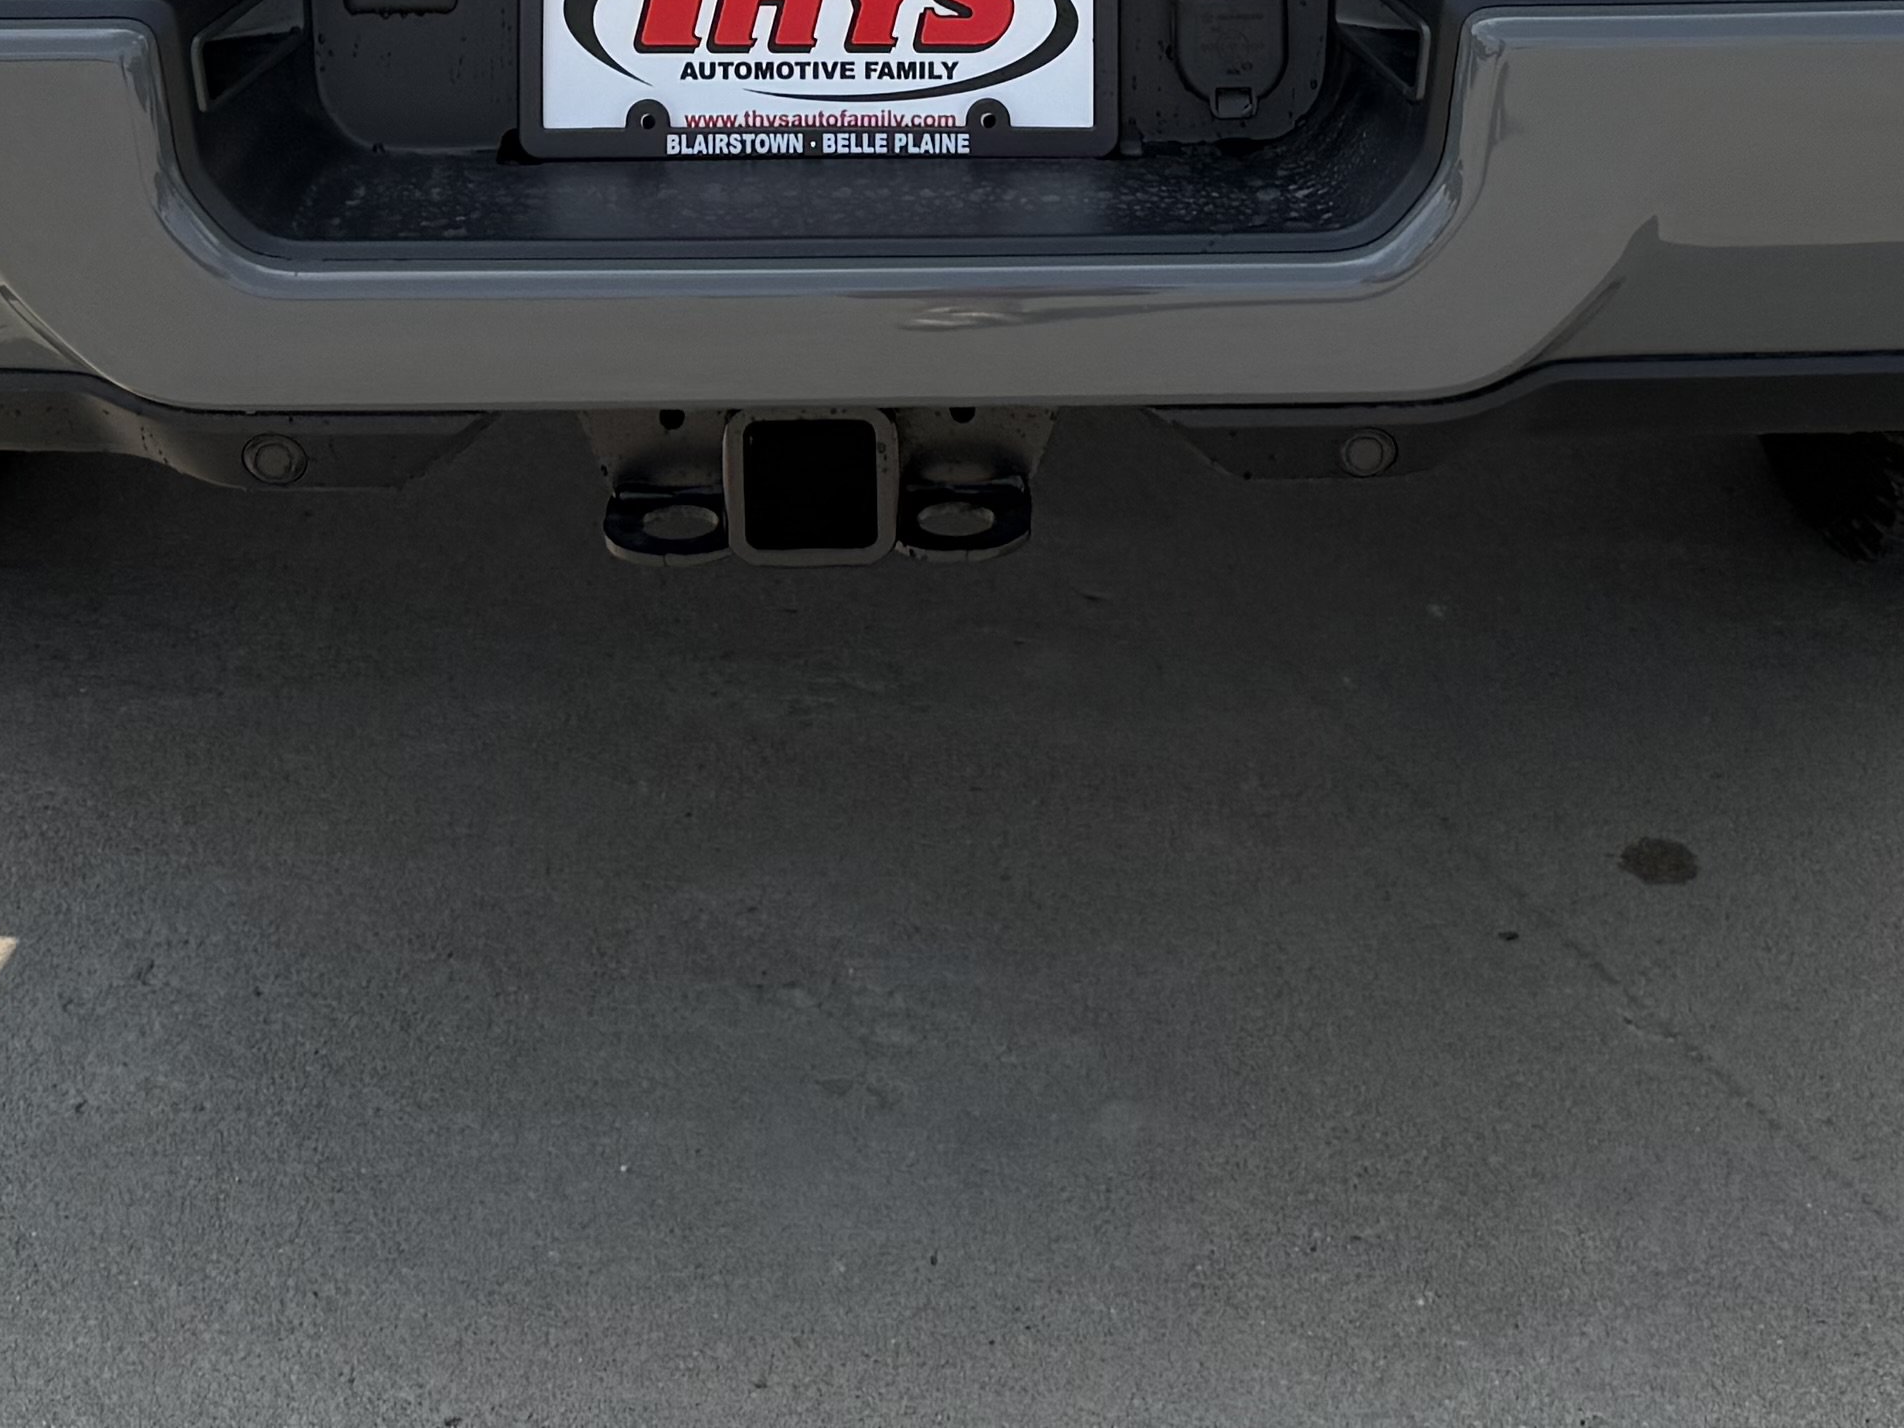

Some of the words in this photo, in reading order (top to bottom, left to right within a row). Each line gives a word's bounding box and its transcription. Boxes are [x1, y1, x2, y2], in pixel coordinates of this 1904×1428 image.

[679, 61, 857, 81] AUTOMOTIVE
[864, 61, 960, 81] FAMILY
[684, 109, 957, 129] www.thysautofamily.com
[666, 133, 804, 156] BLAIRSTOWN
[821, 133, 891, 156] BELLE
[894, 133, 971, 156] PLAINE
